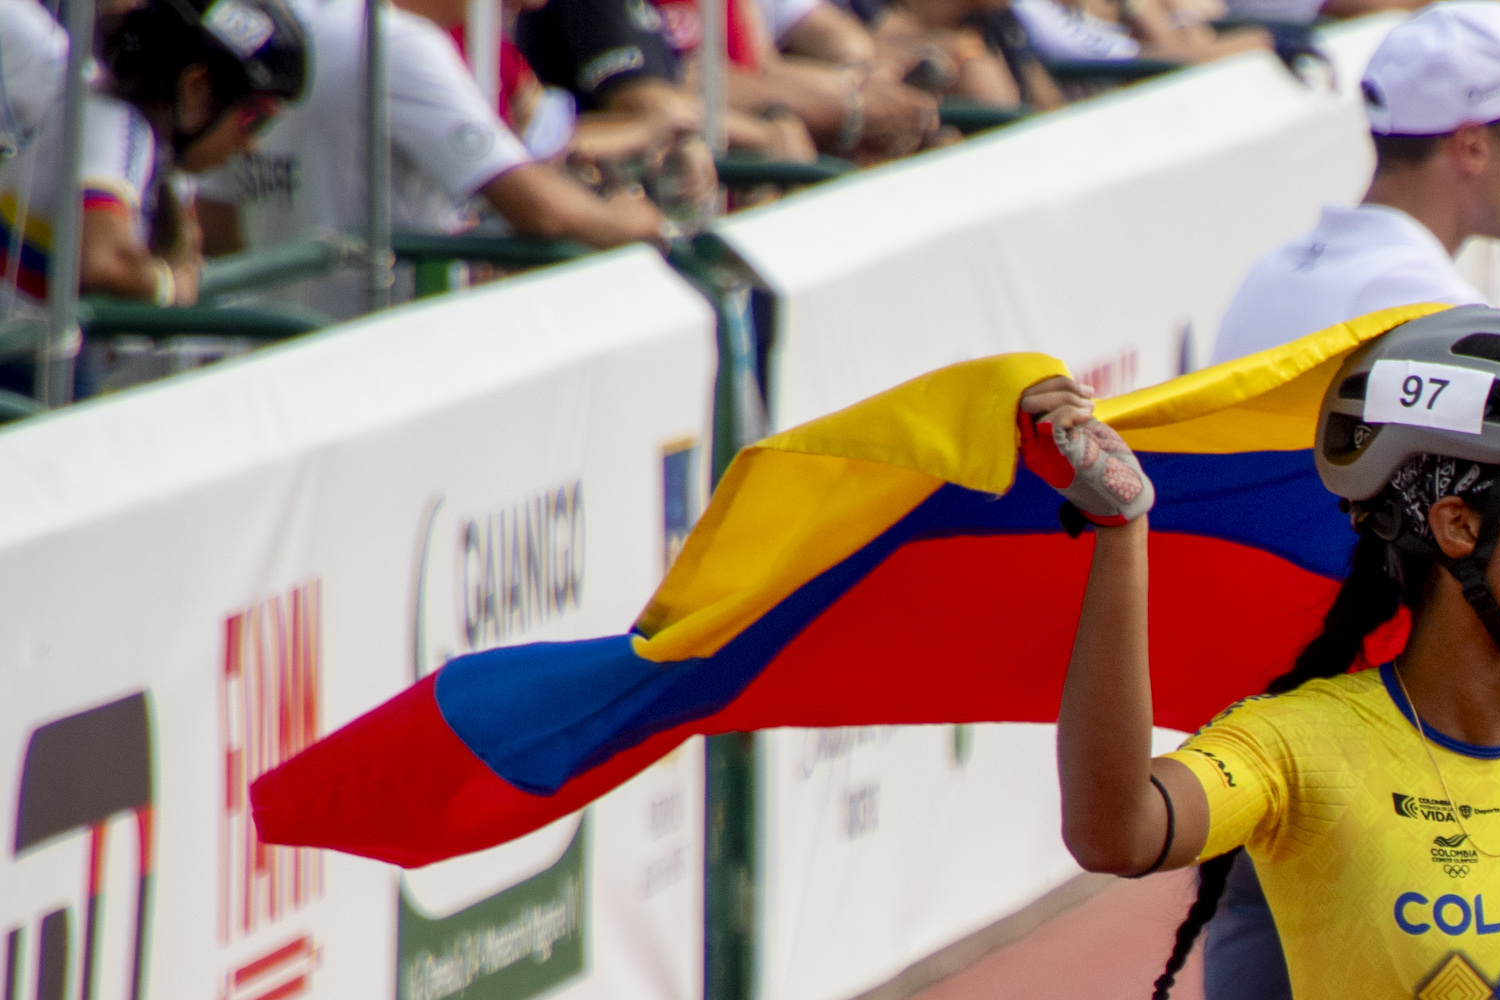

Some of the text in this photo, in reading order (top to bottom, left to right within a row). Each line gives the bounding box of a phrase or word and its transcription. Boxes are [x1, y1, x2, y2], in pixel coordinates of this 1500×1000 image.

[1400, 375, 1450, 411] 97
[1420, 810, 1456, 823] VIDA
[1430, 848, 1478, 858] COLOMBIA
